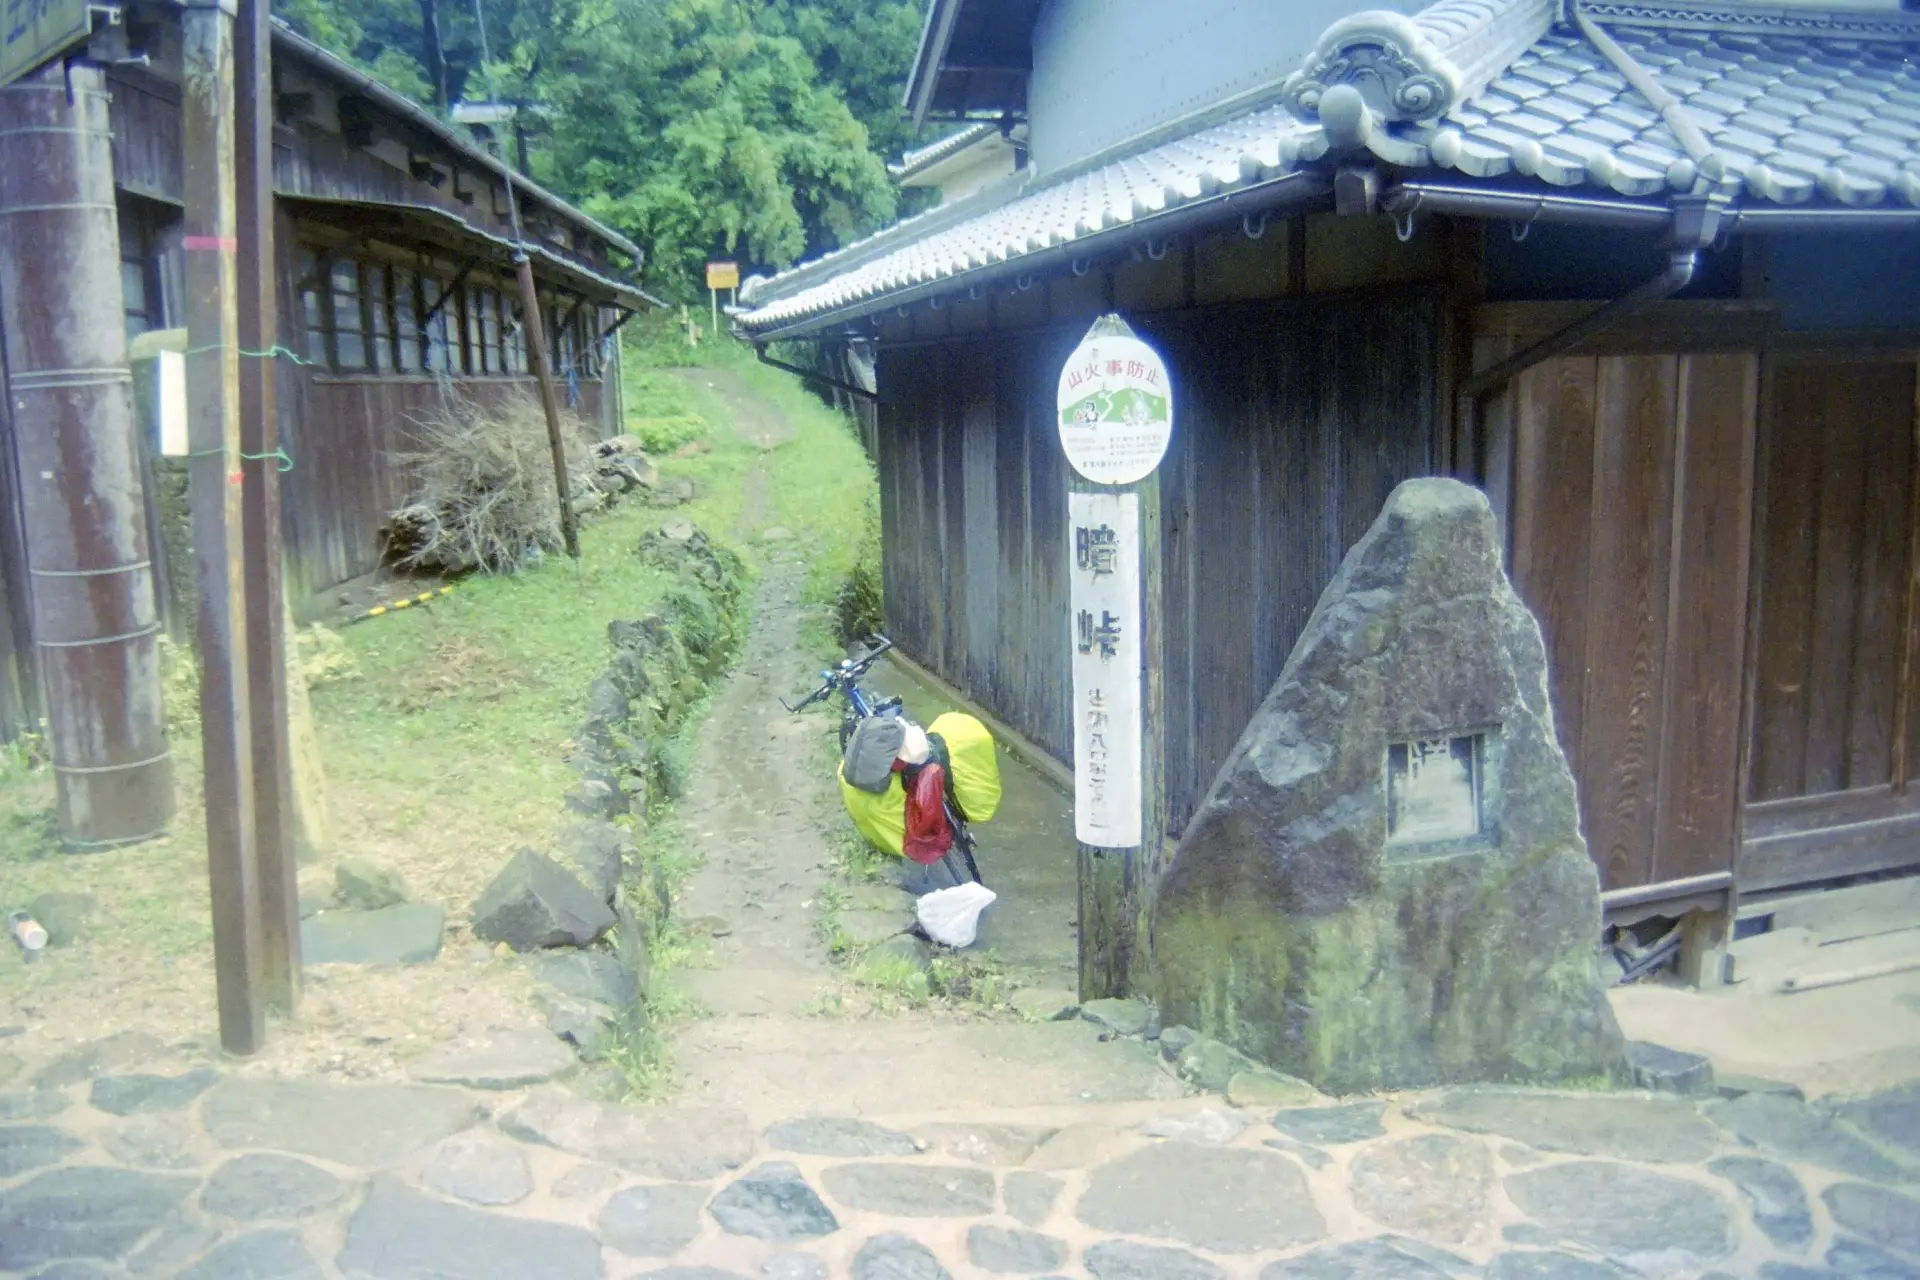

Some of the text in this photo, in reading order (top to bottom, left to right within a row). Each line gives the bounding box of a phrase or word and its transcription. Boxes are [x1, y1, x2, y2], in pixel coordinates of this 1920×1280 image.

[1068, 359, 1159, 389] 山火事防止
